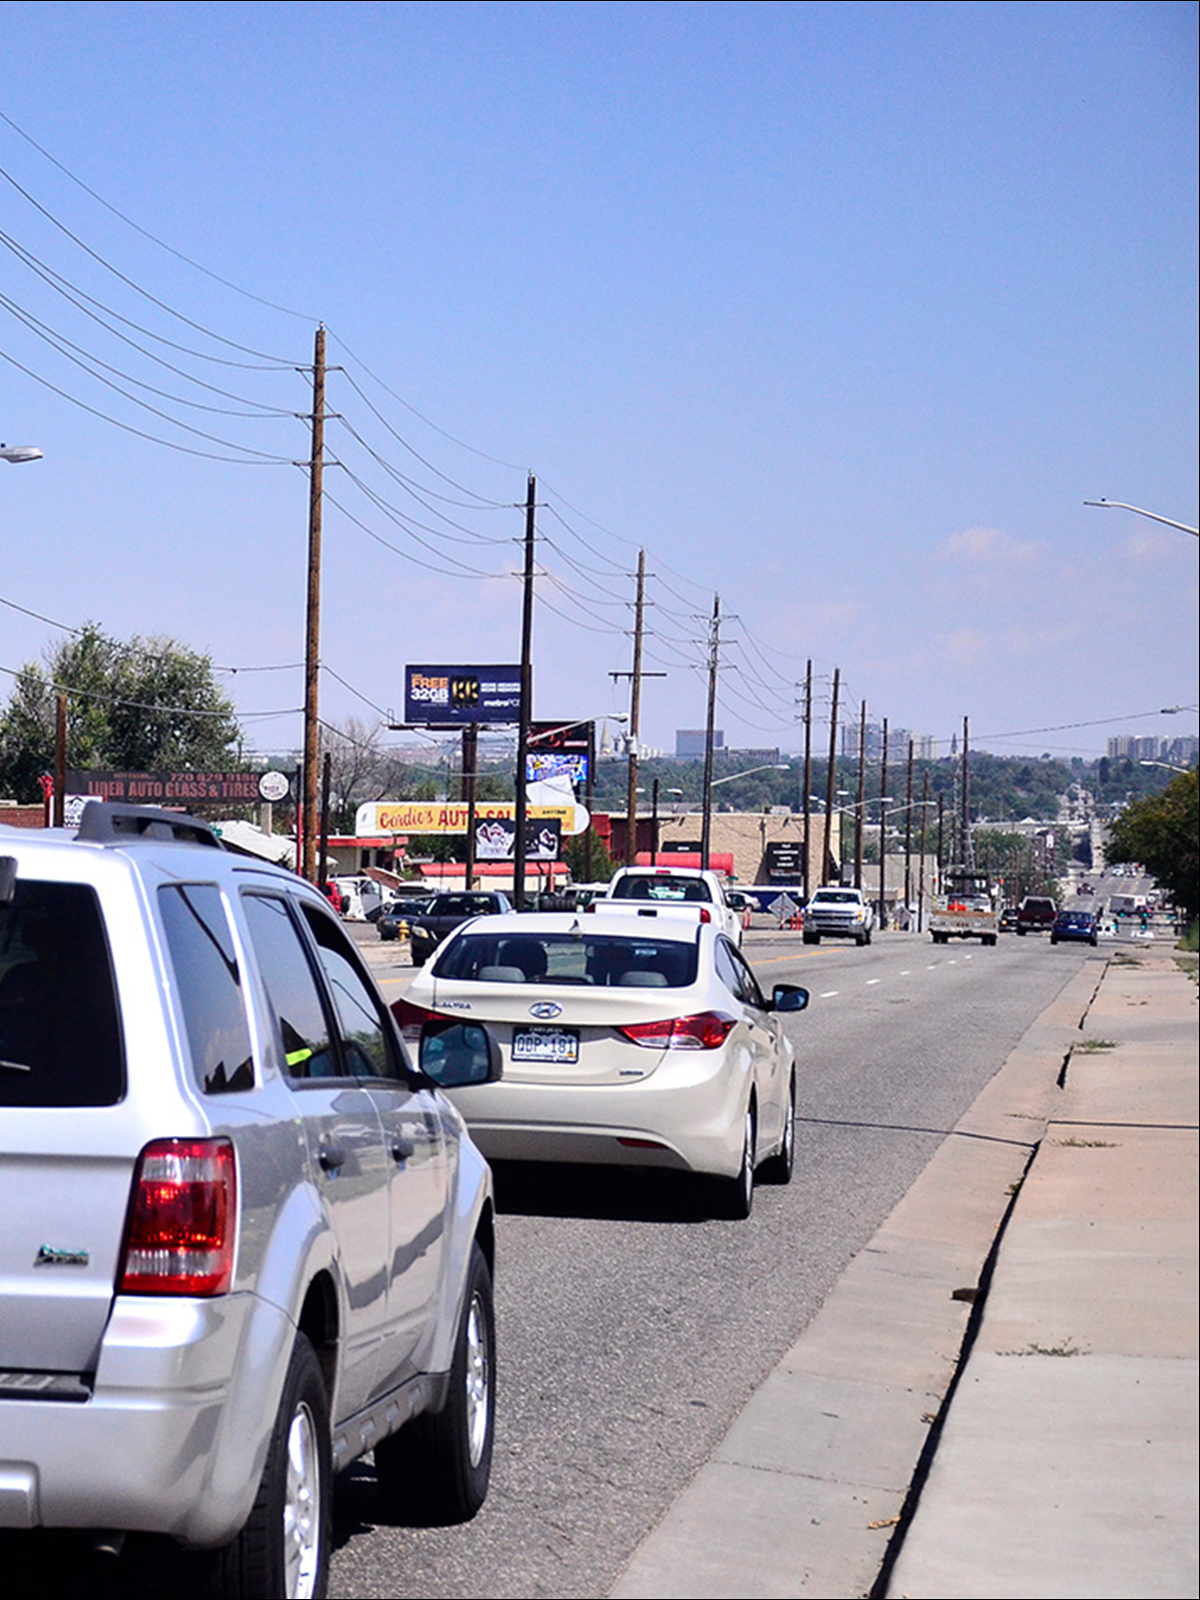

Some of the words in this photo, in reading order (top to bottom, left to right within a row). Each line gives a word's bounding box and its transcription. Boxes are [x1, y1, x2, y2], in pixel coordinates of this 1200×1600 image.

[411, 677, 449, 689] FREE
[410, 689, 449, 700] 32GB
[129, 781, 162, 797] AUTO
[165, 781, 207, 798] GLASS
[208, 783, 218, 798] &
[221, 782, 258, 797] TIRES
[438, 810, 479, 826] AUT
